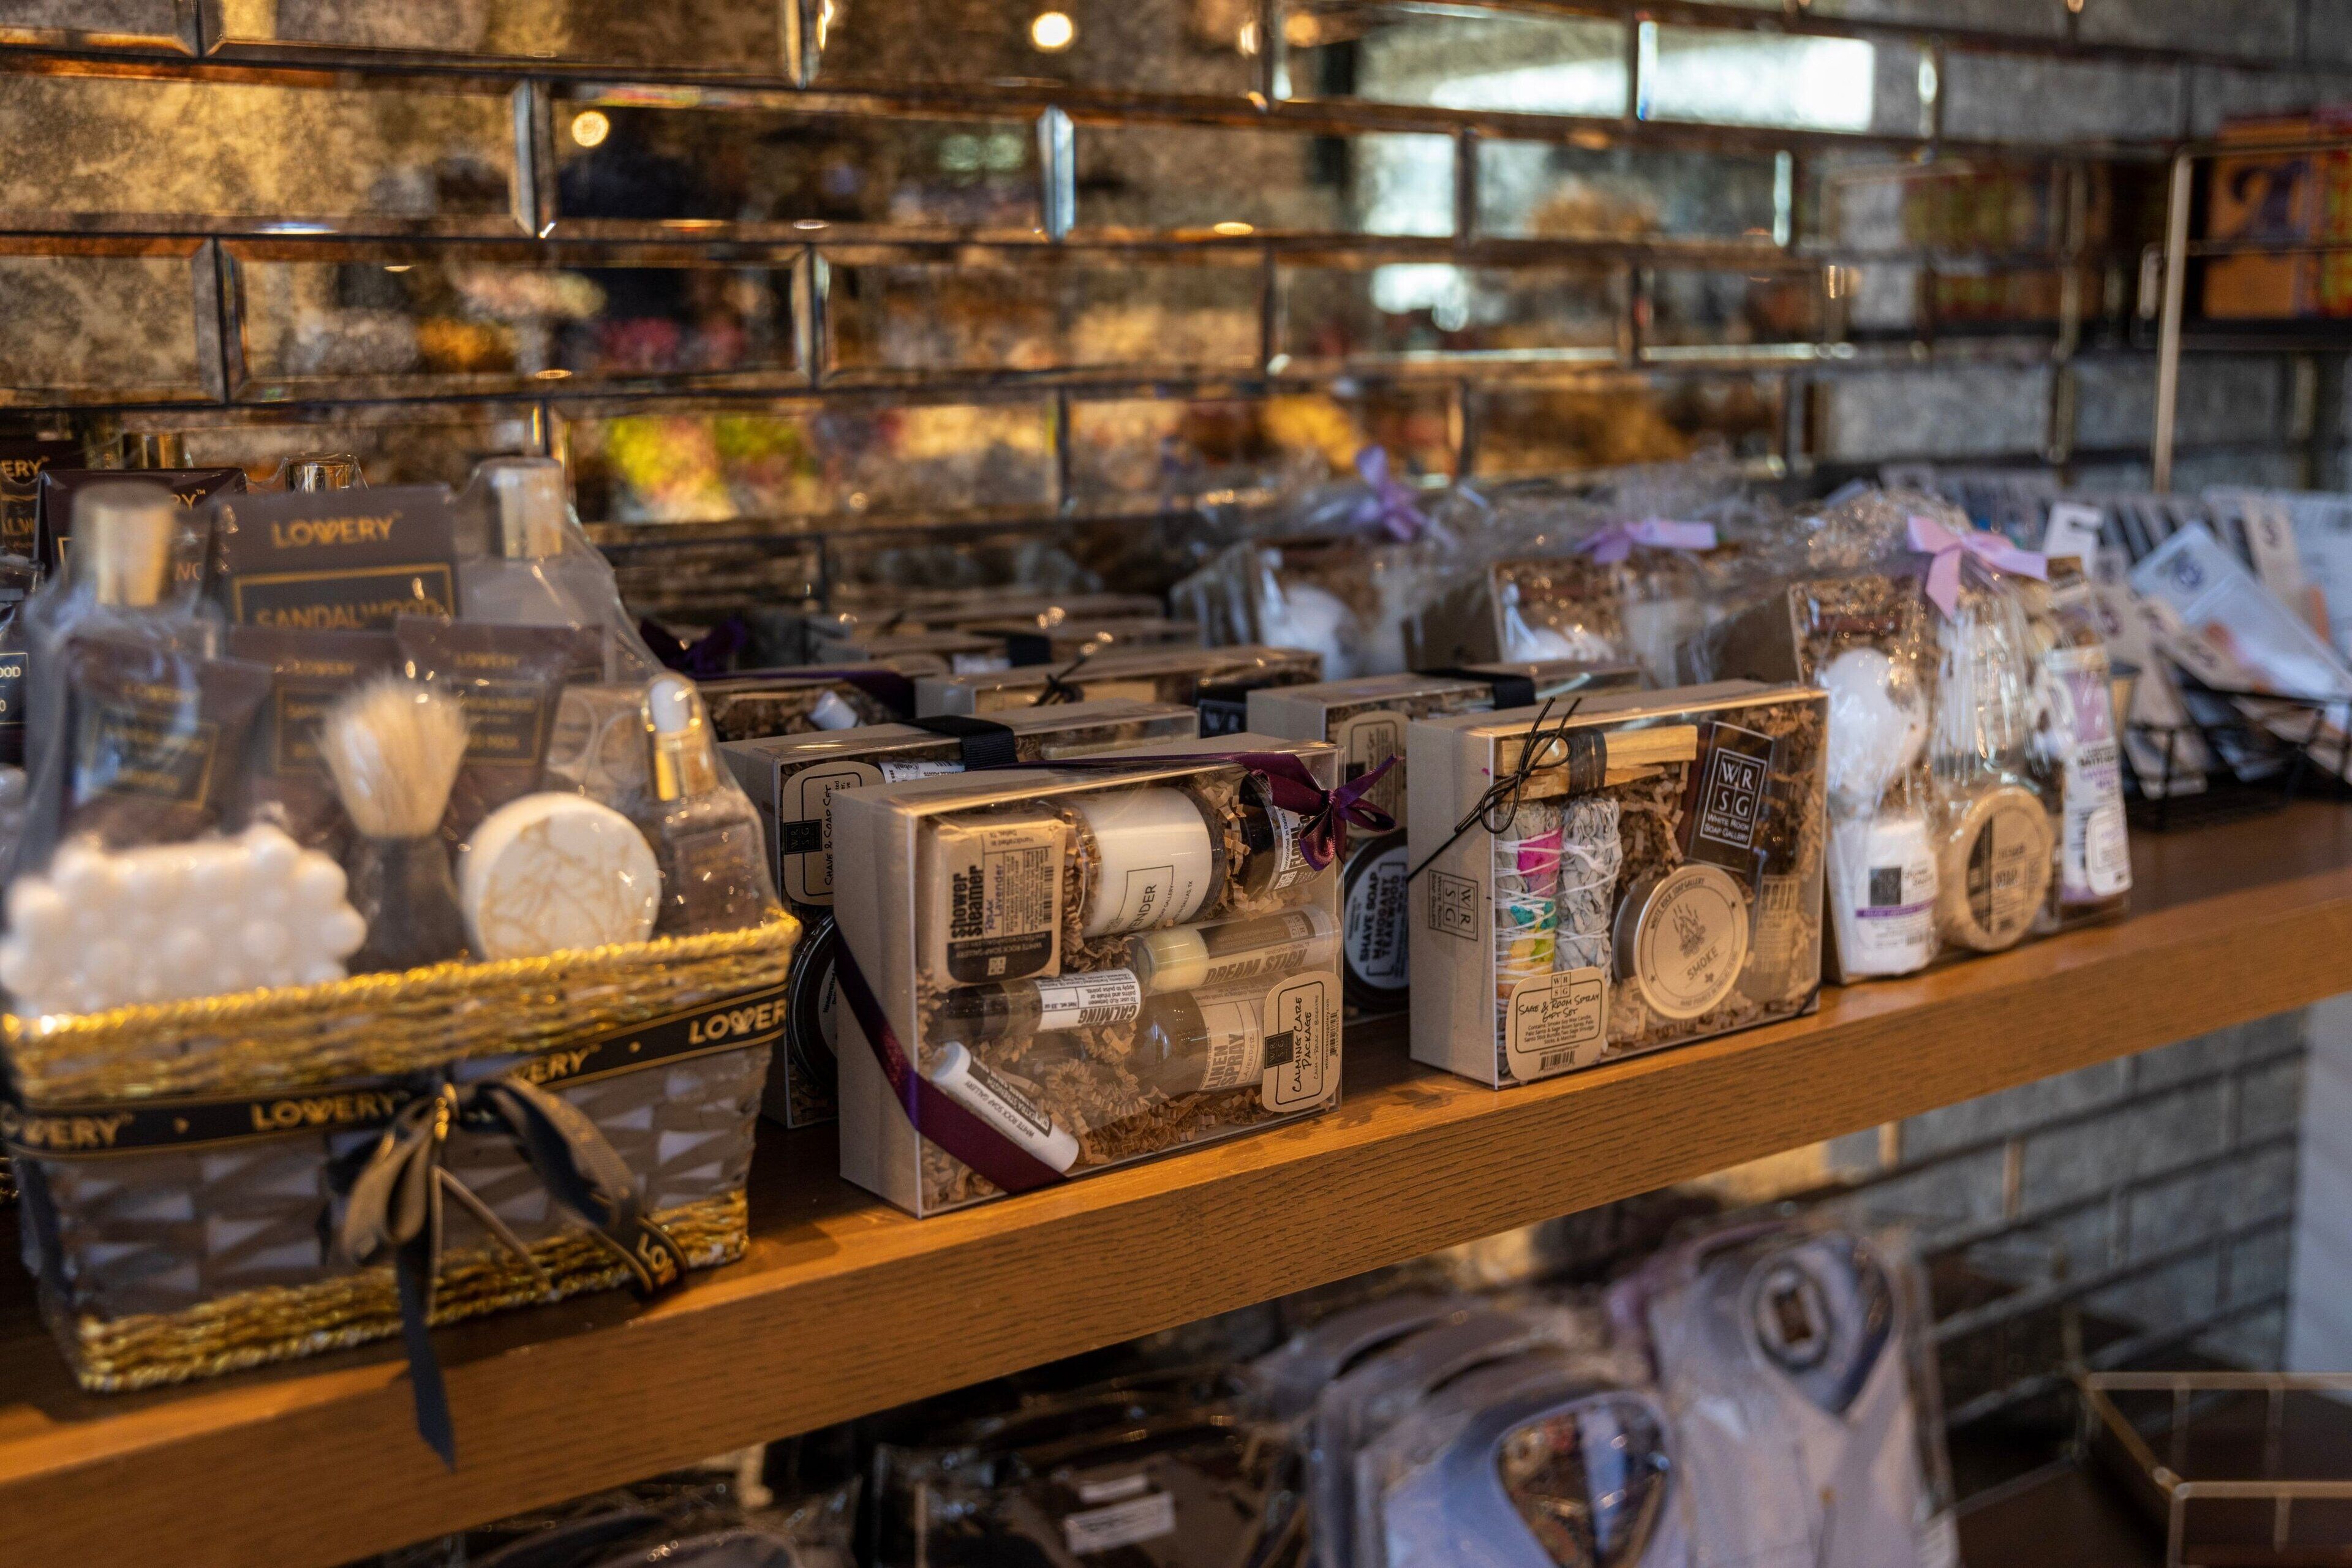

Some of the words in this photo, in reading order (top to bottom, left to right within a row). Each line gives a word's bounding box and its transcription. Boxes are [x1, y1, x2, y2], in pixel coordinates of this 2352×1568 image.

[271, 516, 396, 549] LOVERY
[1283, 838, 1292, 870] Handcrafted
[950, 872, 968, 938] shower
[967, 864, 984, 936] steamer
[993, 864, 1003, 916] Lavender
[1366, 871, 1378, 910] SOAP
[1371, 878, 1389, 960] MAHOGANY
[1382, 874, 1400, 956] TEAKWOOD
[1359, 914, 1374, 962] SHAVE
[1201, 959, 1262, 986] DREAM
[1262, 948, 1308, 974] STICK
[1686, 945, 1719, 981] SMOKE
[1078, 1005, 1137, 1024] CALMING
[1294, 997, 1303, 1032] CARE
[1518, 1004, 1540, 1016] SAGE
[1540, 1000, 1548, 1014] &
[1550, 998, 1572, 1011] ROOM
[1574, 993, 1600, 1006] SPRAY
[1240, 1033, 1254, 1082] LAVENDER
[1301, 1011, 1312, 1070] PACKAGE
[1205, 1044, 1229, 1089] LINEN
[1219, 1033, 1245, 1087] SPRAY
[1292, 1035, 1302, 1093] CALMING
[965, 1080, 990, 1101] GALLERY
[987, 1099, 1005, 1114] SOAP
[251, 1093, 397, 1131] LOVERY
[1003, 1112, 1019, 1125] ROCK
[1016, 1122, 1035, 1139] WHITE
